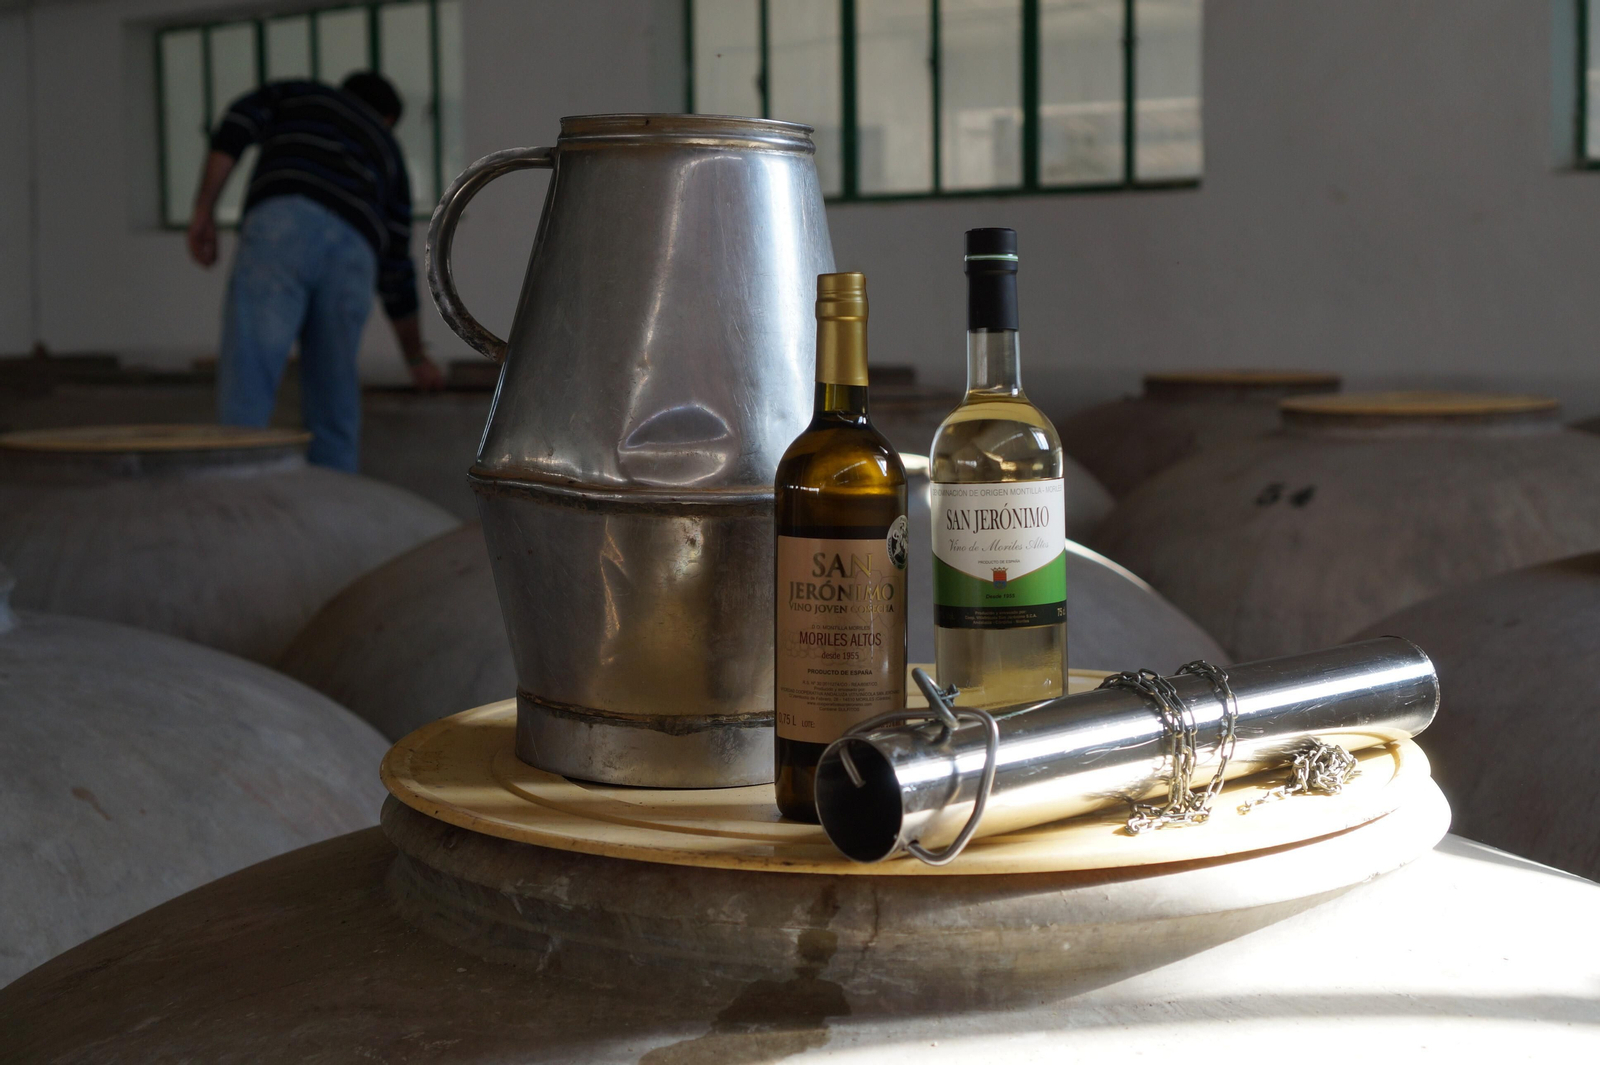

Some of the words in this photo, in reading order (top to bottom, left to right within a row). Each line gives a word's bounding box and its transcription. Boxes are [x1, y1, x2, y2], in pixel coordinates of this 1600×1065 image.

[969, 489, 978, 497] DE
[980, 488, 1009, 497] ORIGEN
[1010, 486, 1042, 496] MONTILLA
[946, 508, 971, 531] SAN
[972, 502, 1050, 534] JERÓNIMO
[947, 538, 967, 552] Vino
[968, 541, 980, 552] de
[981, 538, 1023, 552] Moriles
[1025, 536, 1050, 551] Altos
[812, 552, 873, 579] SAN
[788, 580, 895, 602] JERÓNIMO
[788, 601, 812, 612] VINO
[814, 604, 848, 614] JOVEN
[799, 631, 848, 647] MORILES
[850, 632, 882, 647] ALTOS
[821, 651, 841, 660] desde
[842, 652, 859, 660] 1955
[807, 668, 840, 676] PRODUCTO
[801, 720, 816, 728] LOTE:
